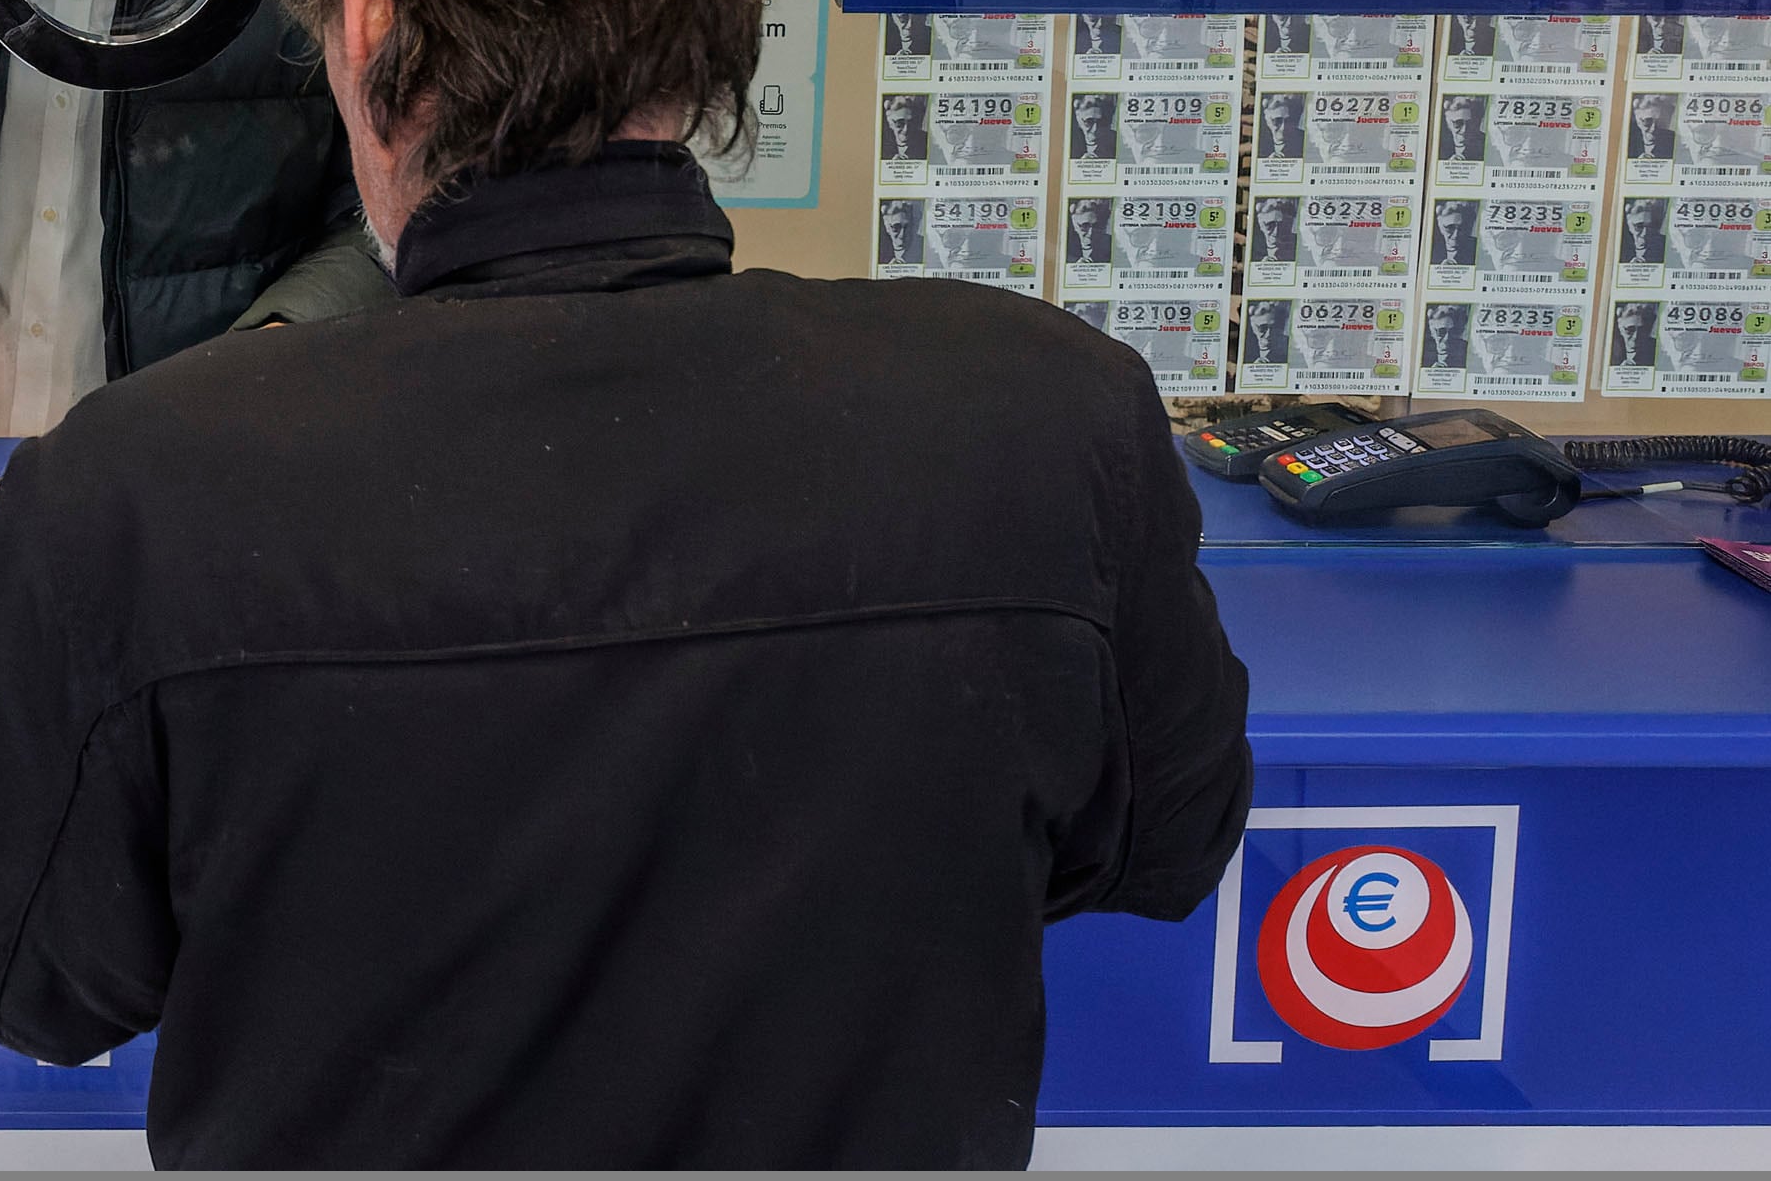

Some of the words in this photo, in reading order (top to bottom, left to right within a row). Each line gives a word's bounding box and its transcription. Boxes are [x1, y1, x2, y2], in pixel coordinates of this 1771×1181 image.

[937, 99, 1012, 115] 54190
[1128, 99, 1202, 115] 82109
[1315, 97, 1390, 113] 06278
[1497, 101, 1573, 118] 78235
[1686, 97, 1762, 114] 49086
[1123, 202, 1197, 219] 82109
[1300, 305, 1375, 321] 06278
[1384, 351, 1391, 359] 3
